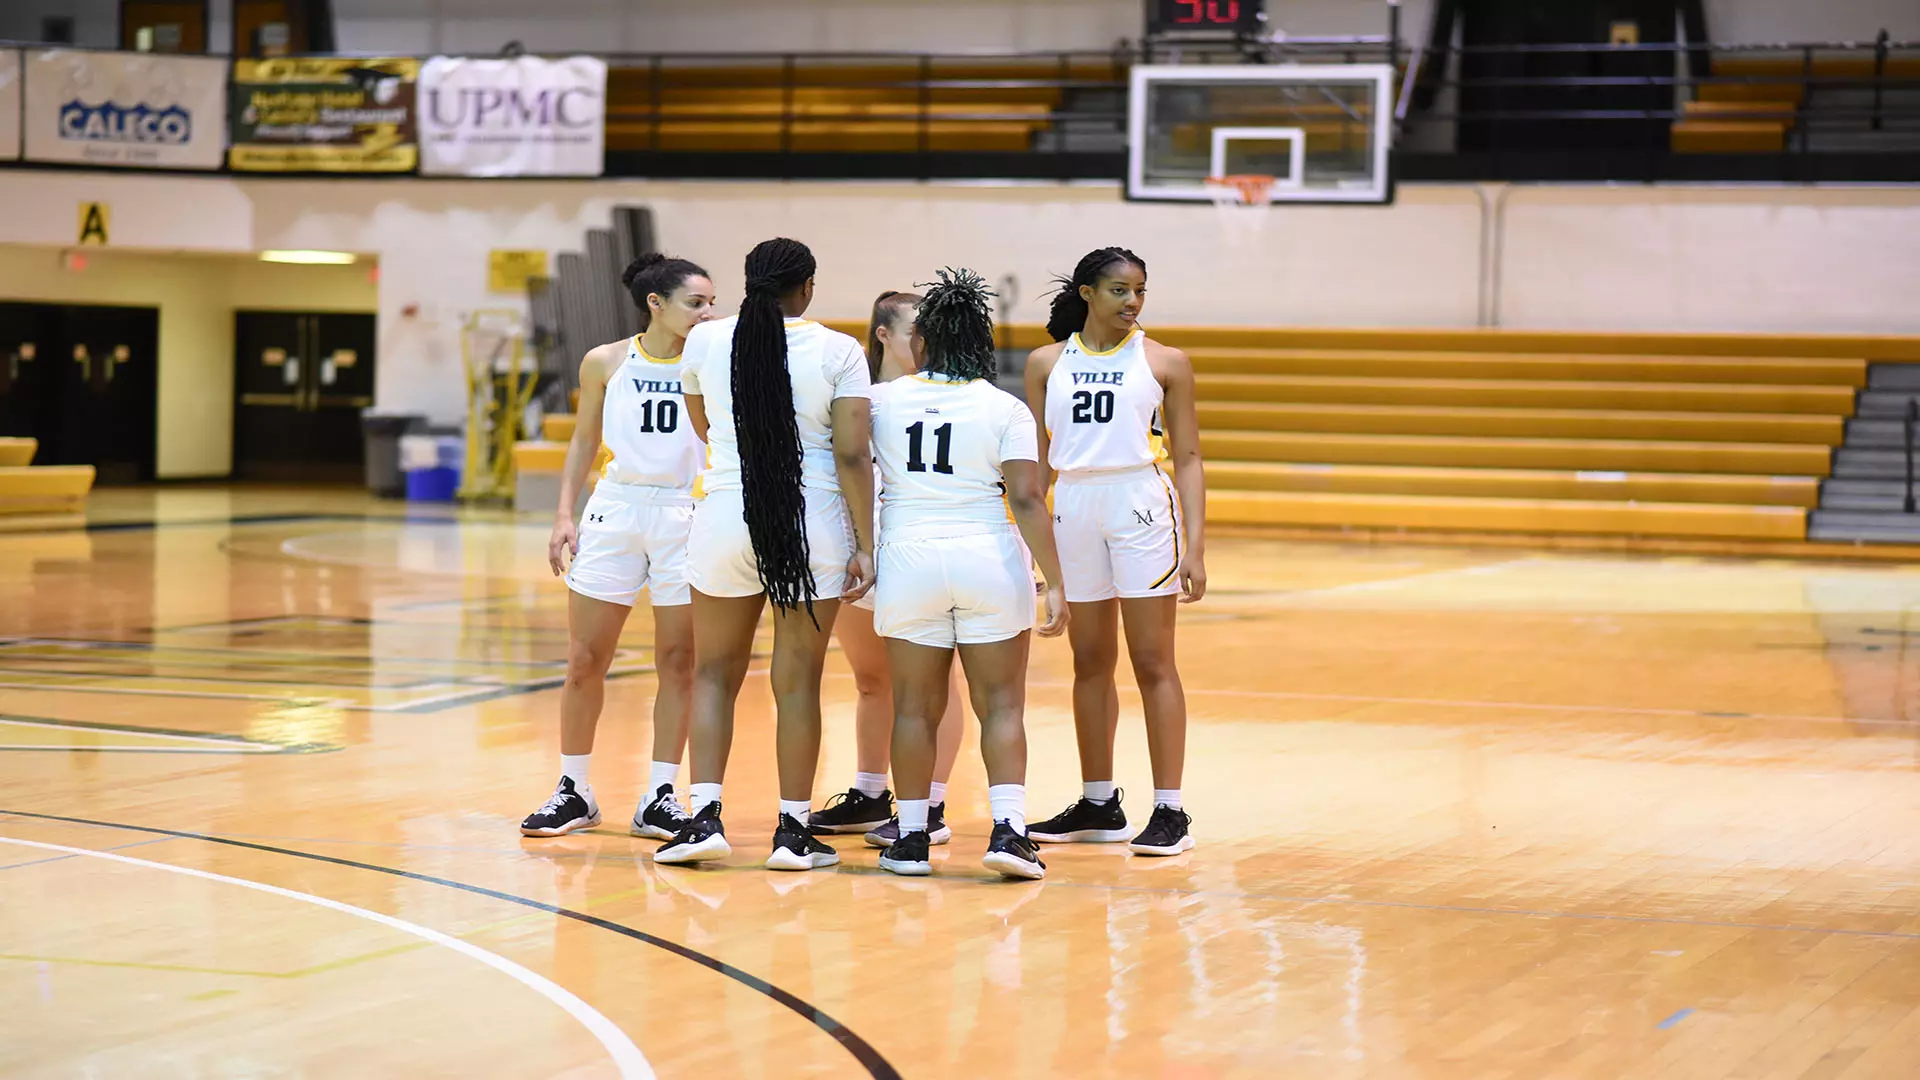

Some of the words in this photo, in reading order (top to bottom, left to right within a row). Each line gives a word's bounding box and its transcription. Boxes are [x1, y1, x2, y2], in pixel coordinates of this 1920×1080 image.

[62, 106, 189, 143] CALECO
[427, 87, 601, 130] UPMC
[80, 204, 106, 244] A
[1072, 371, 1124, 386] VILLE
[640, 399, 678, 433] 10
[1072, 390, 1115, 423] 20
[905, 420, 954, 474] 11
